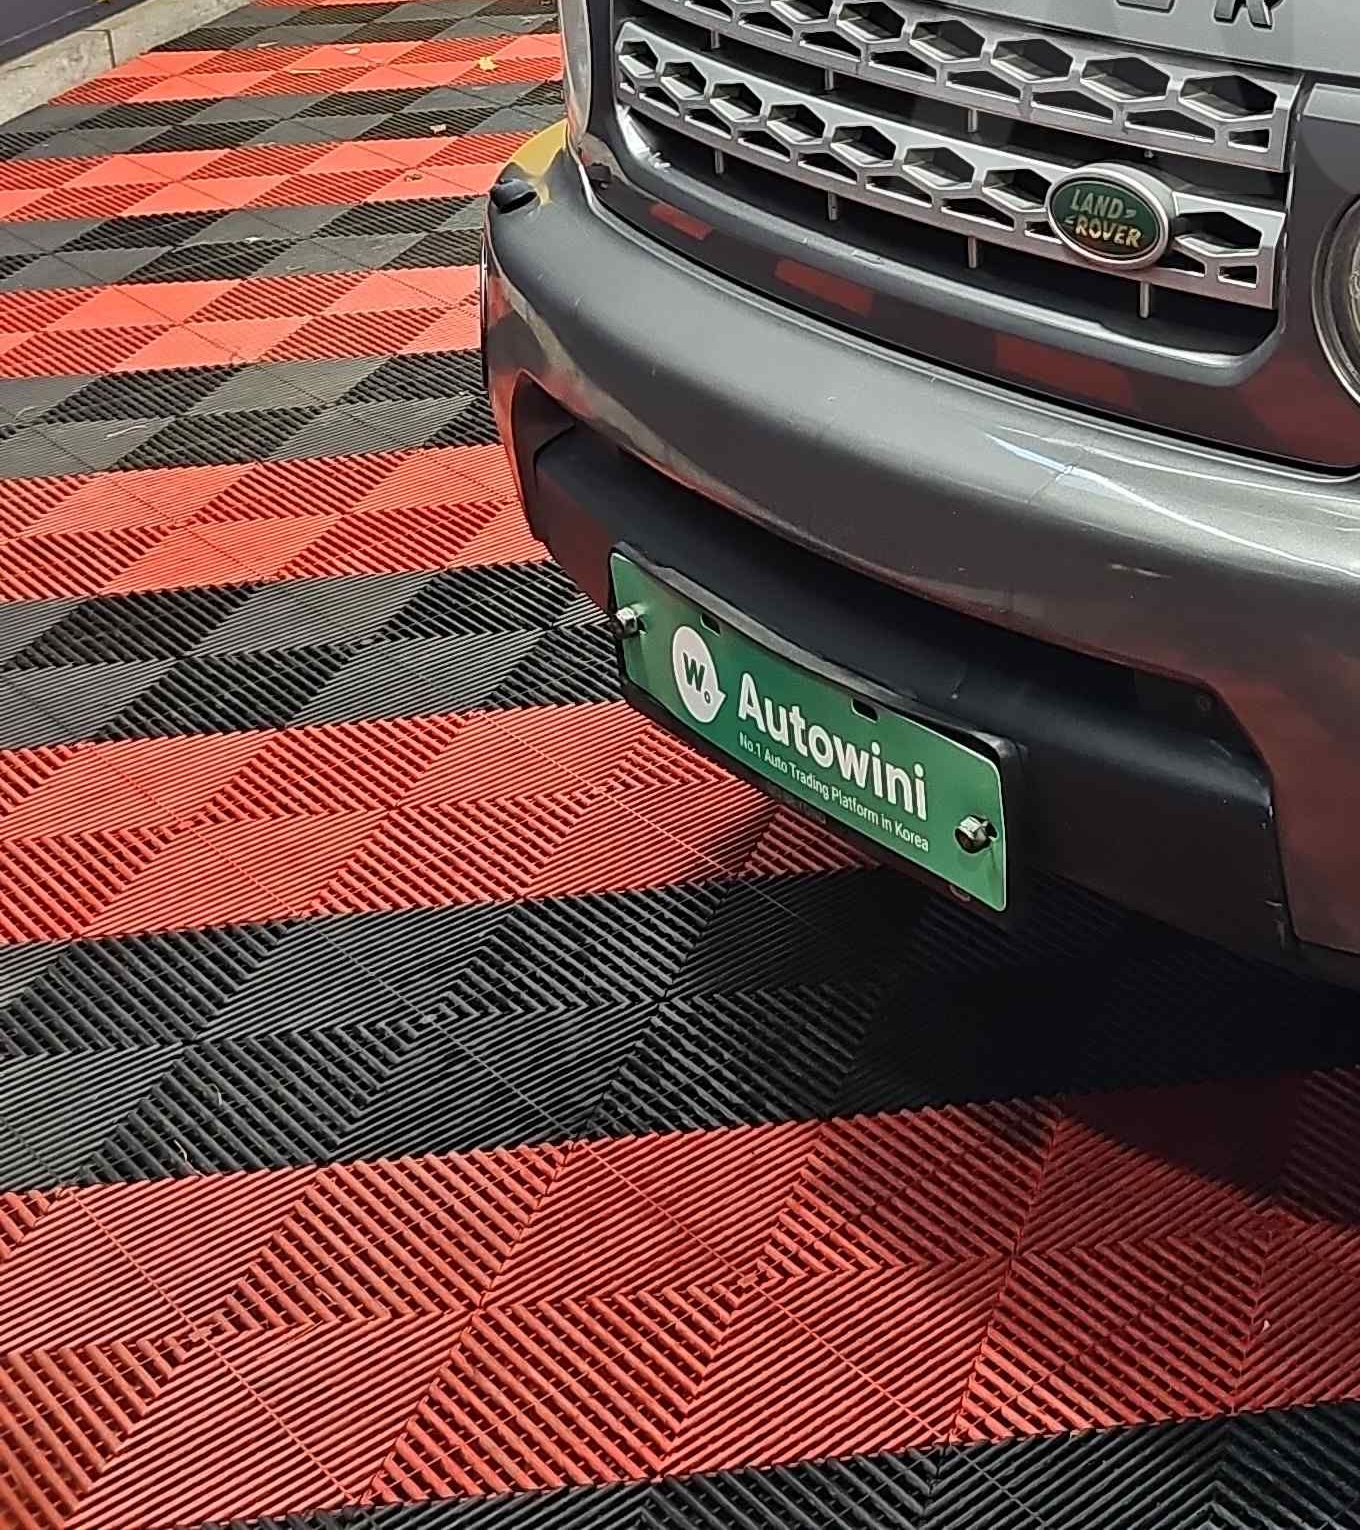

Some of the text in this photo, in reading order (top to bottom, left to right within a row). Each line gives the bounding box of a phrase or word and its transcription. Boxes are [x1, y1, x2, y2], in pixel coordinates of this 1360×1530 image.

[1070, 189, 1124, 220] LAND
[1075, 214, 1142, 248] ROVER
[738, 673, 927, 822] Autowini
[739, 731, 762, 758] No.1
[764, 749, 788, 774] Auto
[788, 761, 830, 801] Trading
[831, 785, 880, 826] Platform
[881, 813, 893, 833] in
[894, 819, 929, 852] Korea
